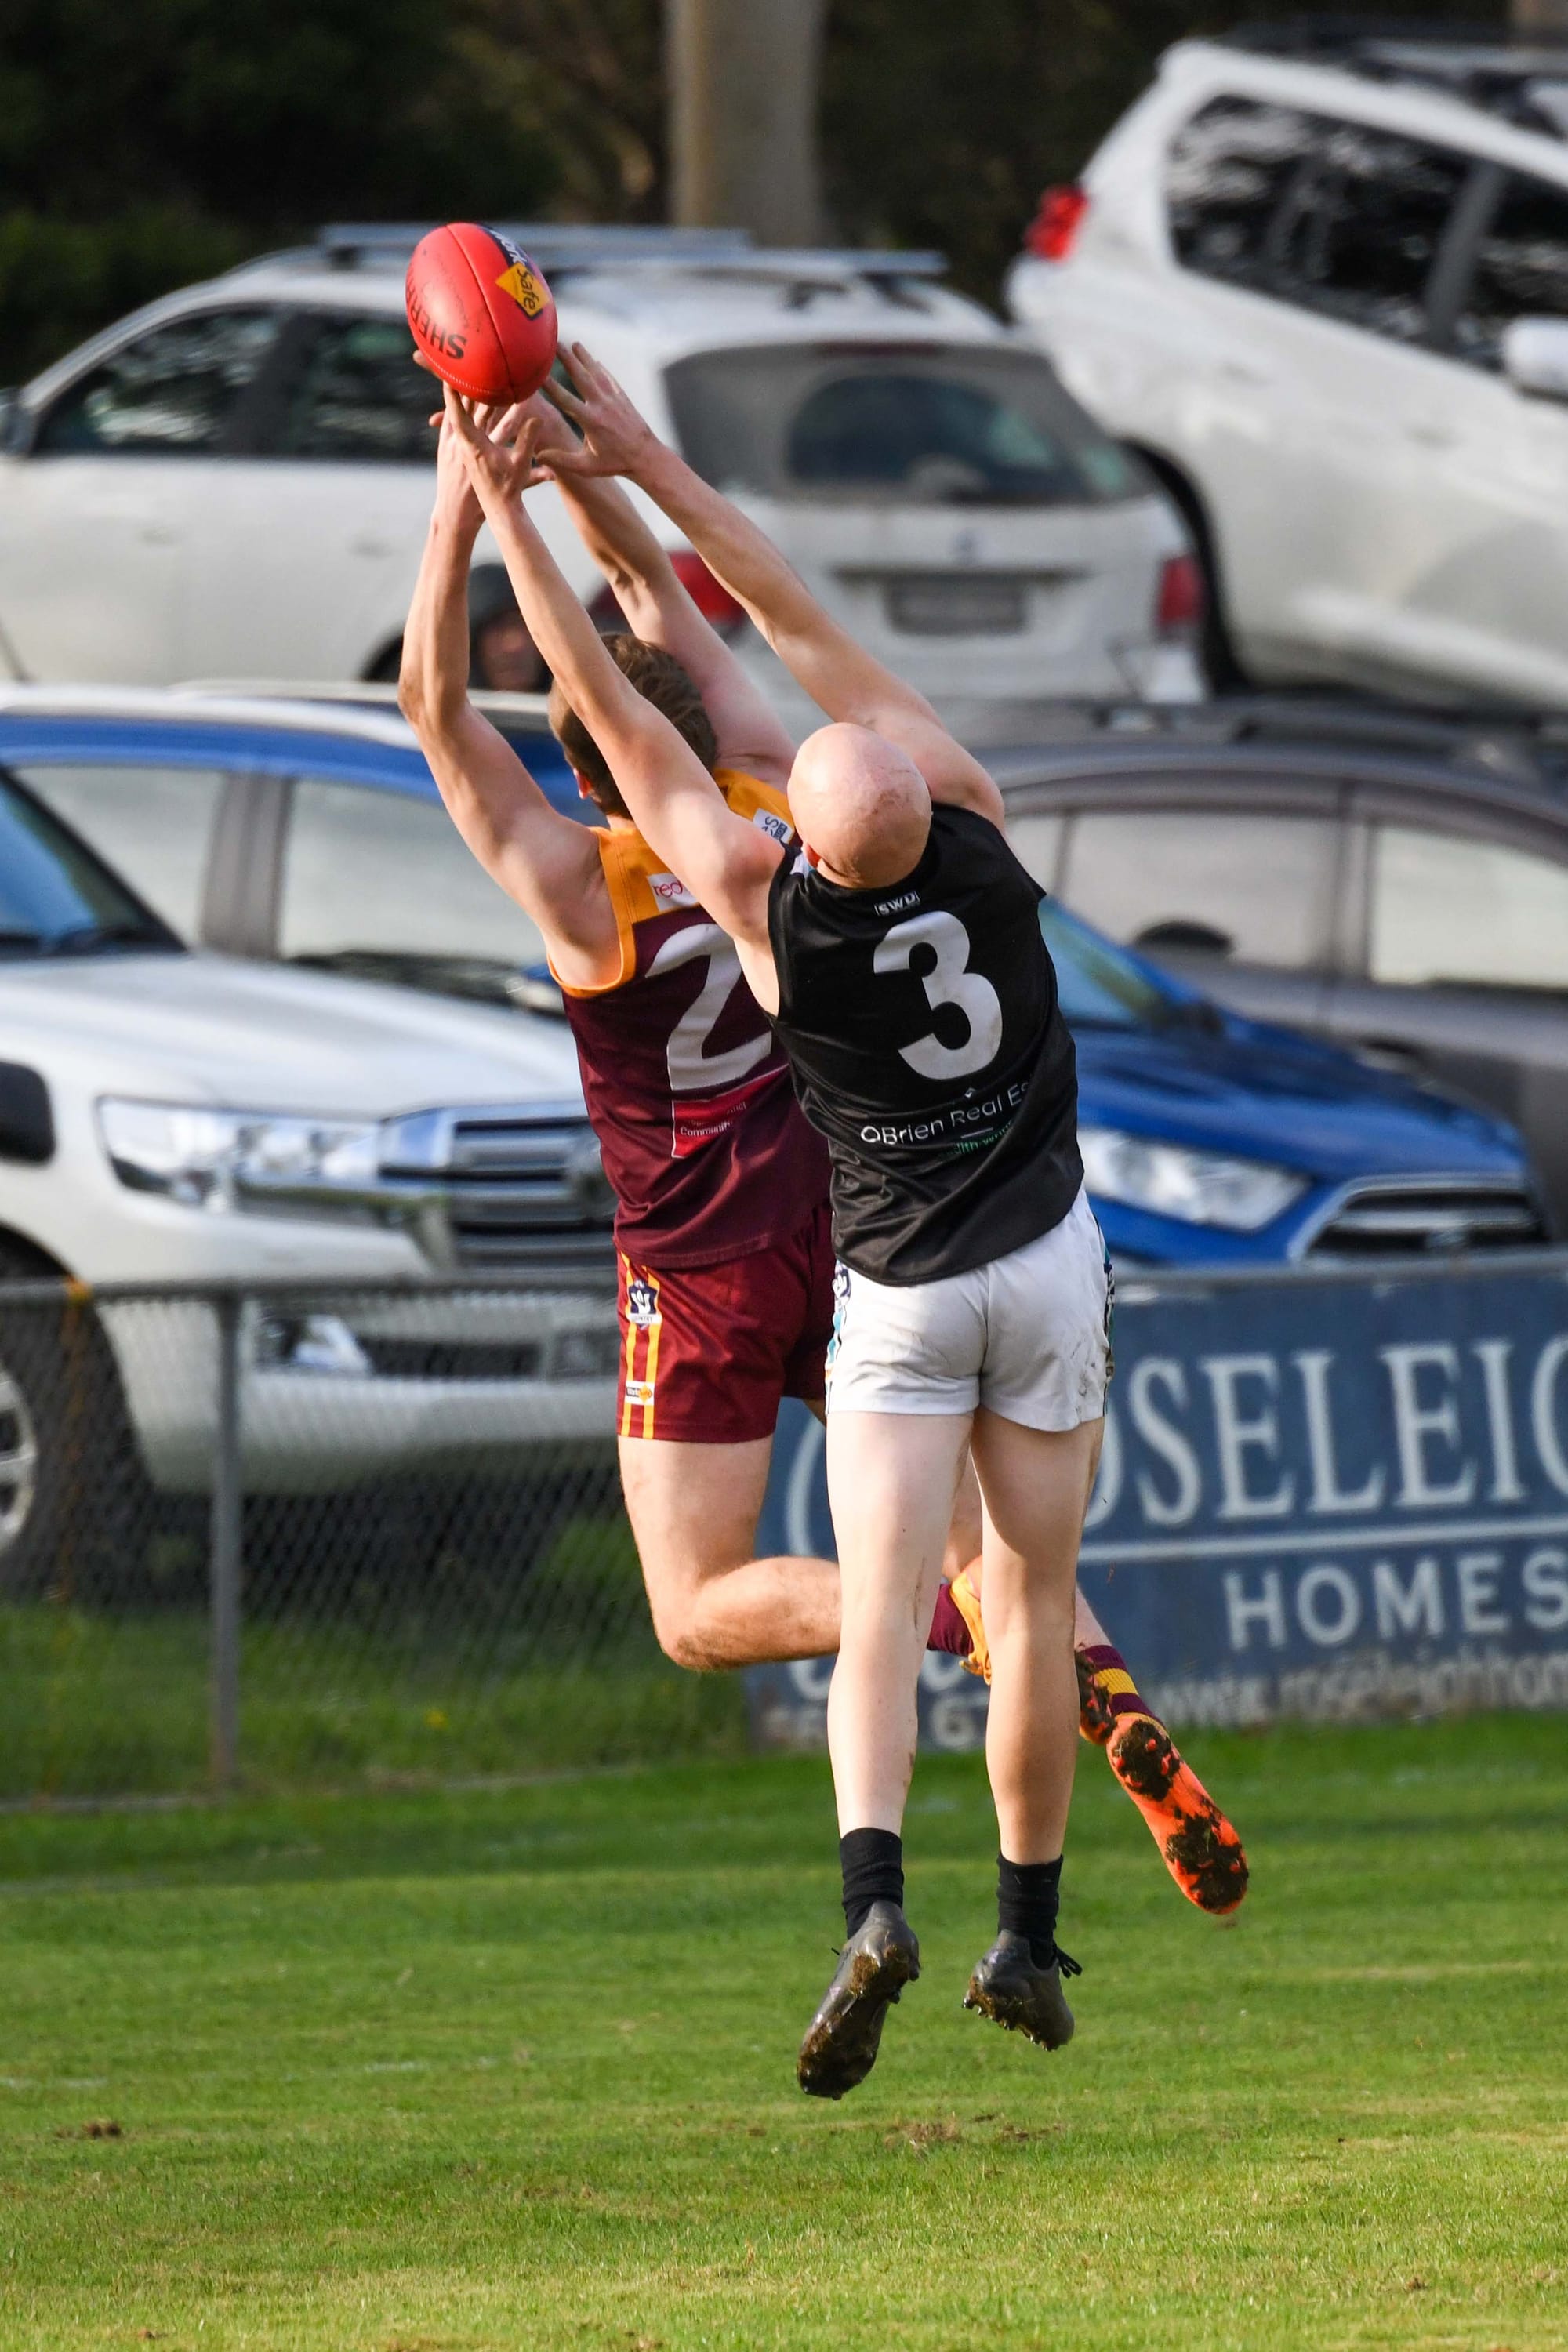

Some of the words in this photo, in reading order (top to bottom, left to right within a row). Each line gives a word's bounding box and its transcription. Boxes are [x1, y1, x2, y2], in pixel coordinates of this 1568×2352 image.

[645, 924, 771, 1091] 2
[873, 910, 1003, 1080] 3
[861, 1120, 944, 1145] OBrien
[950, 1094, 1002, 1127] Real
[1223, 1547, 1568, 1649] HOMES
